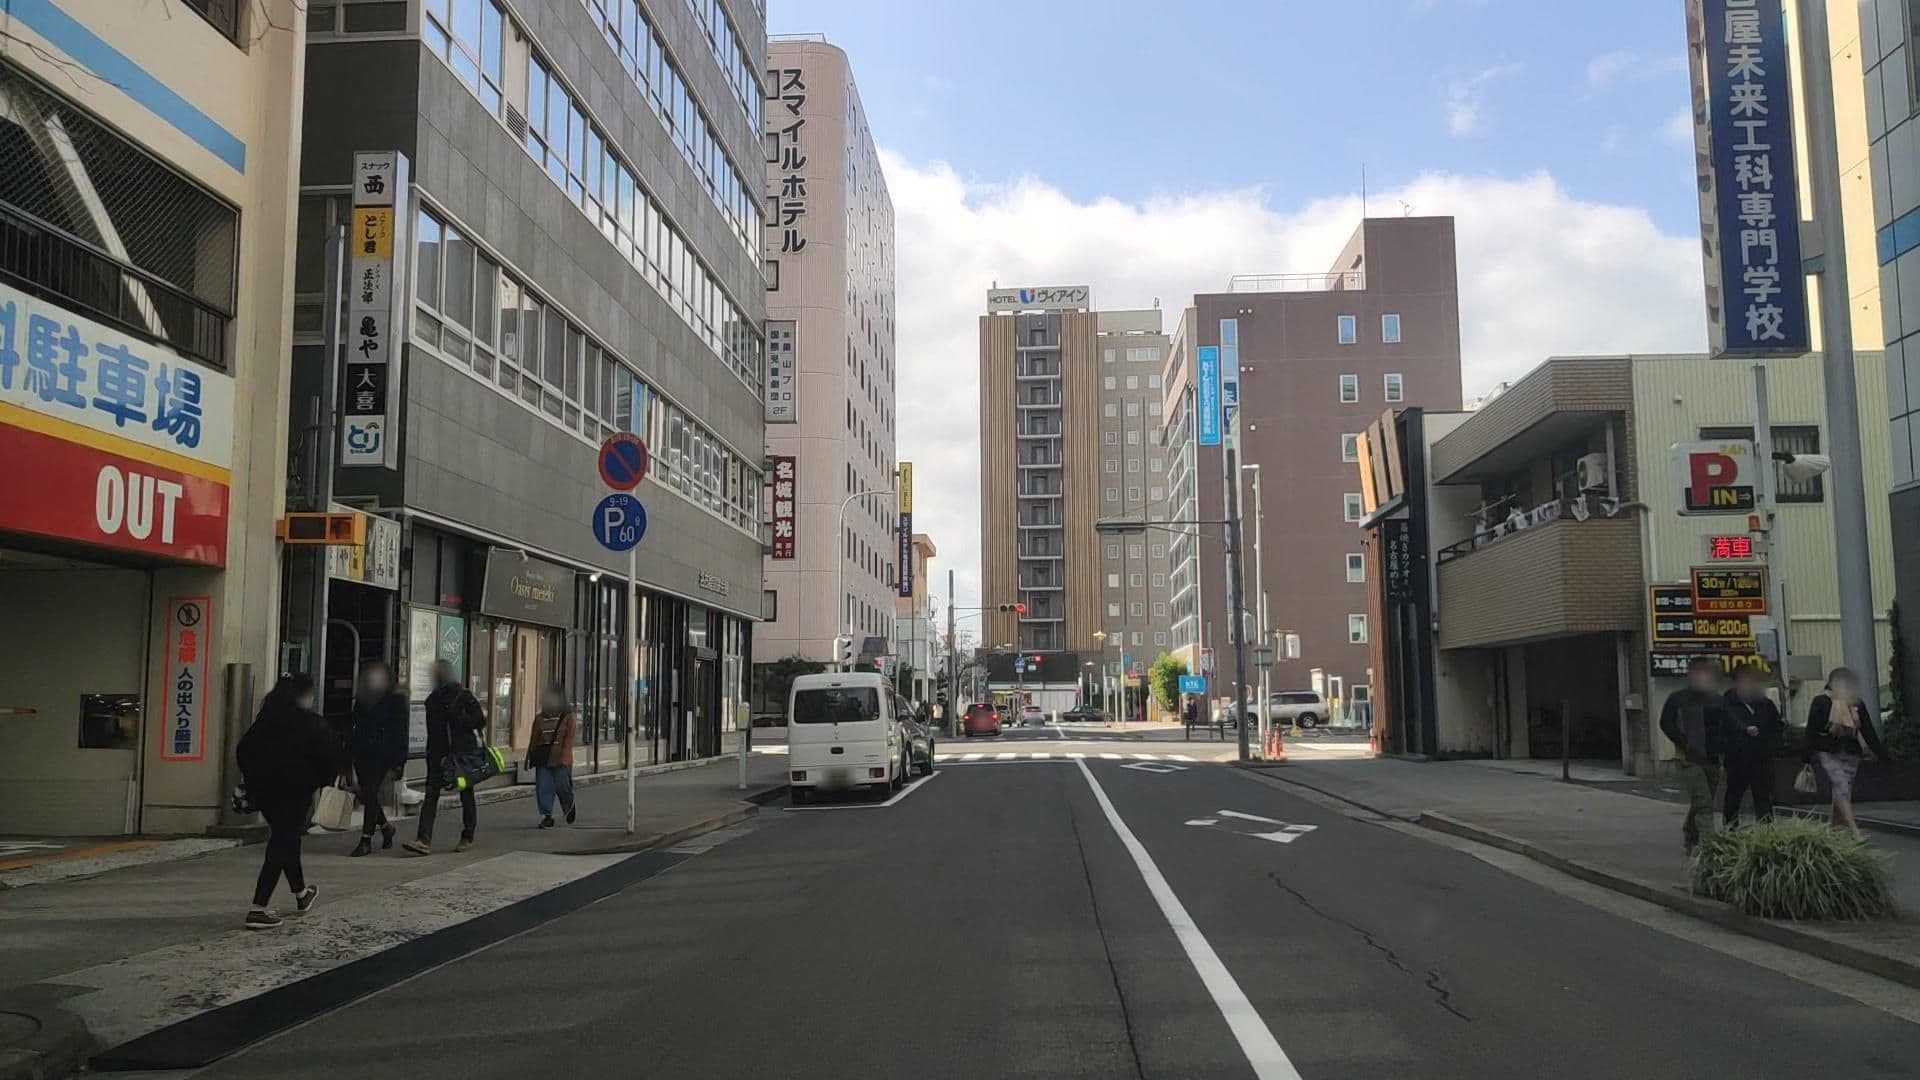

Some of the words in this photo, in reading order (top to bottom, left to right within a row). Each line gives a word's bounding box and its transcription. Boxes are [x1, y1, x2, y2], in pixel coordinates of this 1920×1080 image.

[361, 162, 390, 170] スナック
[781, 68, 807, 253] スマイルホテル
[1723, 0, 1785, 341] 屋未来工科専門学校
[364, 175, 385, 195] 西
[990, 296, 1017, 304] HOTEL
[1038, 289, 1087, 303] ヴィアイン
[359, 316, 378, 359] 亀や
[356, 368, 377, 411] 大喜
[772, 406, 788, 415] 2F
[1689, 453, 1738, 507] P
[95, 464, 183, 545] OUT
[1713, 489, 1738, 506] IN
[605, 507, 625, 544] P
[619, 526, 635, 542] 60
[1711, 537, 1753, 559] 満車
